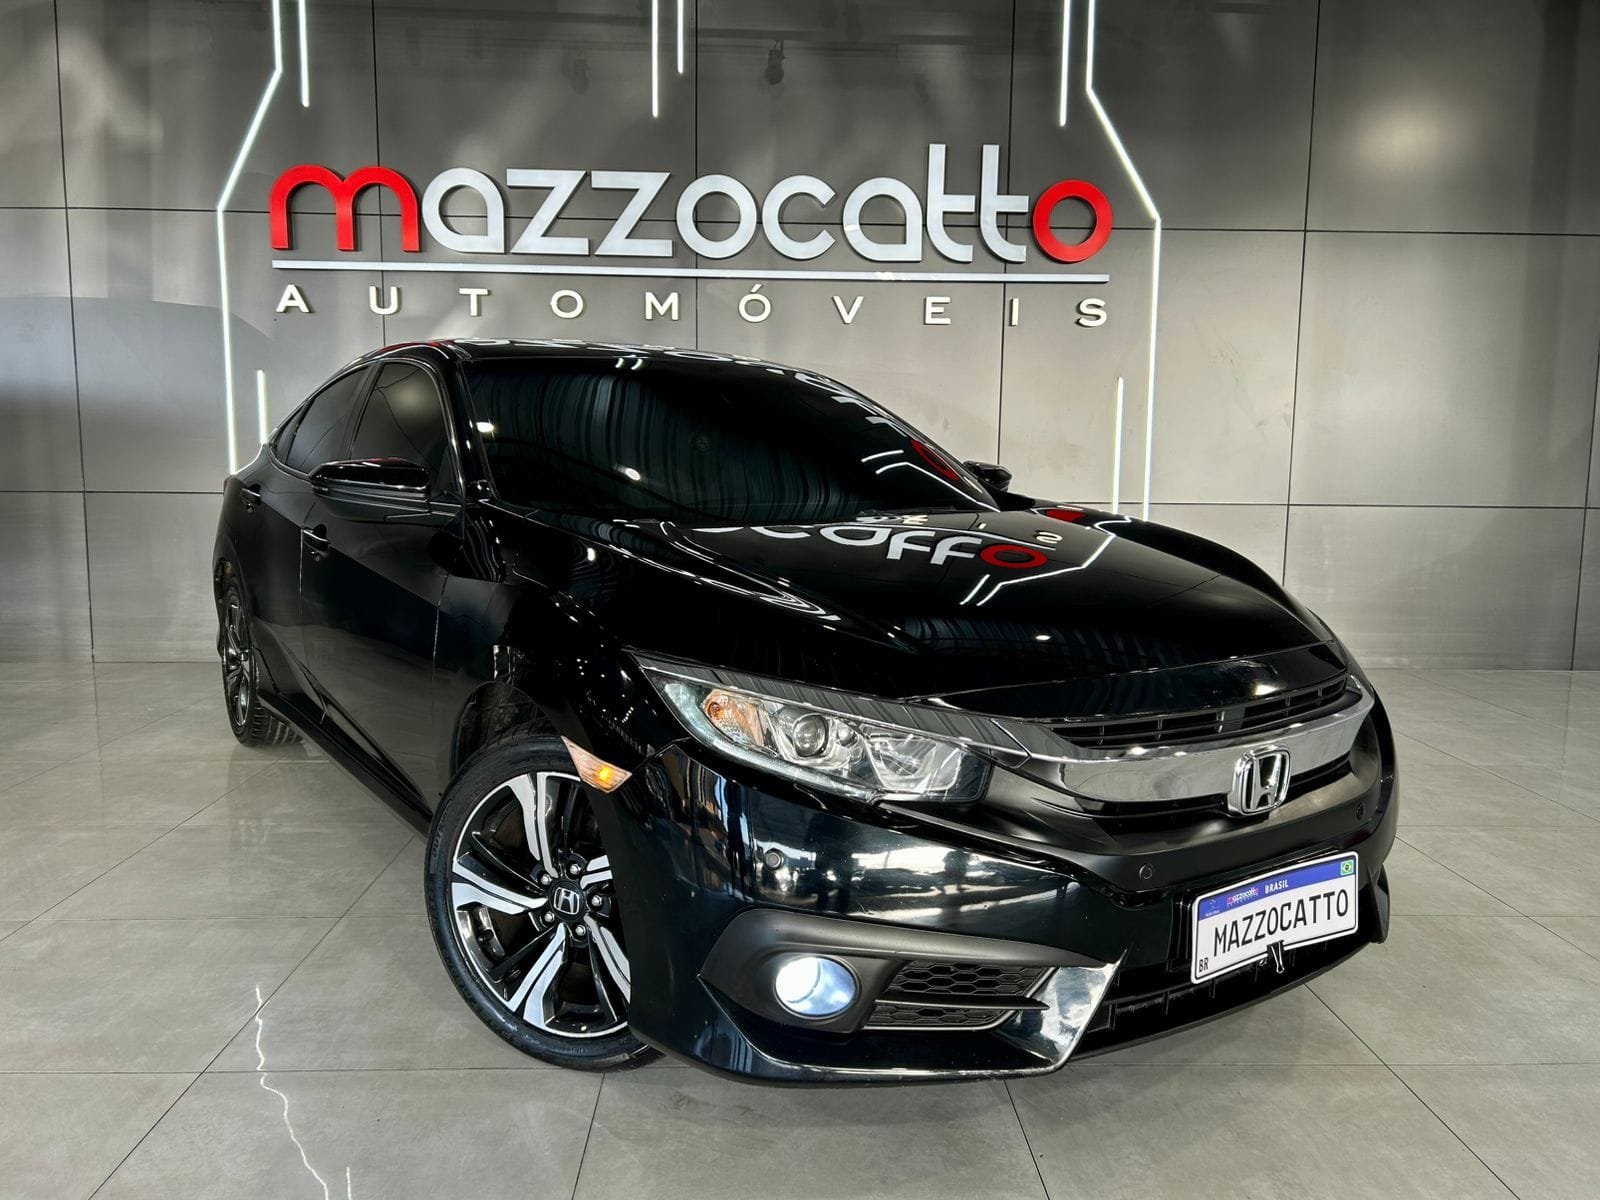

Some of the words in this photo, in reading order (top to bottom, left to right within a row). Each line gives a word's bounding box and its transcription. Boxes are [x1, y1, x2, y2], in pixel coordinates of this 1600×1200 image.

[269, 144, 1113, 263] mazzocatto
[276, 284, 1108, 328] AUTOMÓVEIS
[1264, 879, 1289, 894] BRASIL
[1213, 889, 1349, 957] MAZZOCATTO
[1199, 957, 1209, 972] BR
